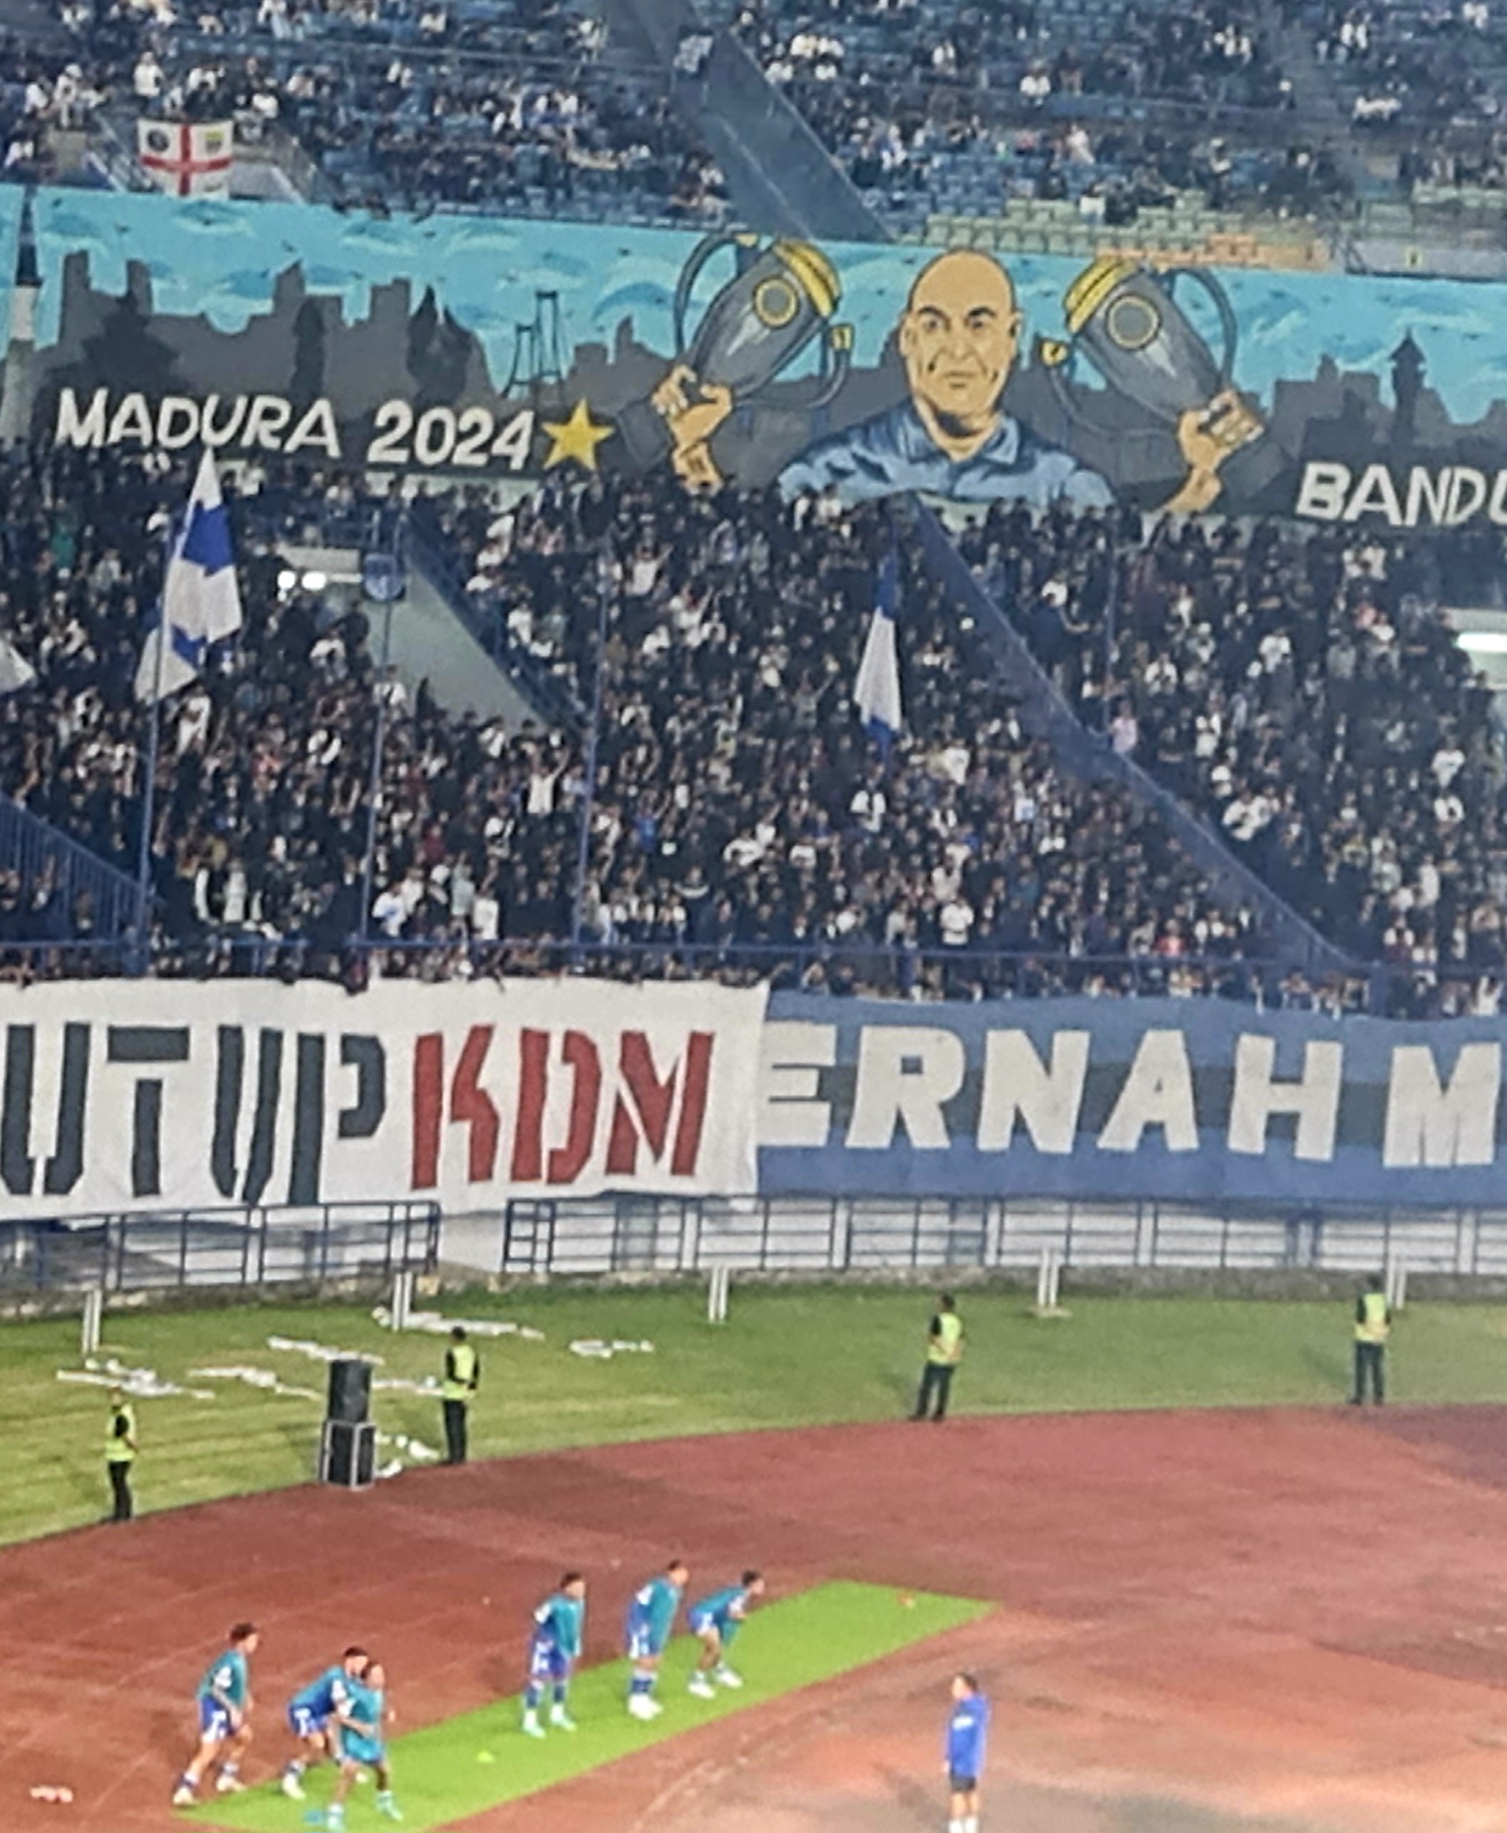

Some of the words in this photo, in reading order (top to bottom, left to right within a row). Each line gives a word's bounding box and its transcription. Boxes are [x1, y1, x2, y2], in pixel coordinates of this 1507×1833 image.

[53, 387, 341, 459] MADURA
[366, 400, 535, 471] 2024
[210, 1023, 389, 1205] UP
[410, 1023, 716, 1192] KDM
